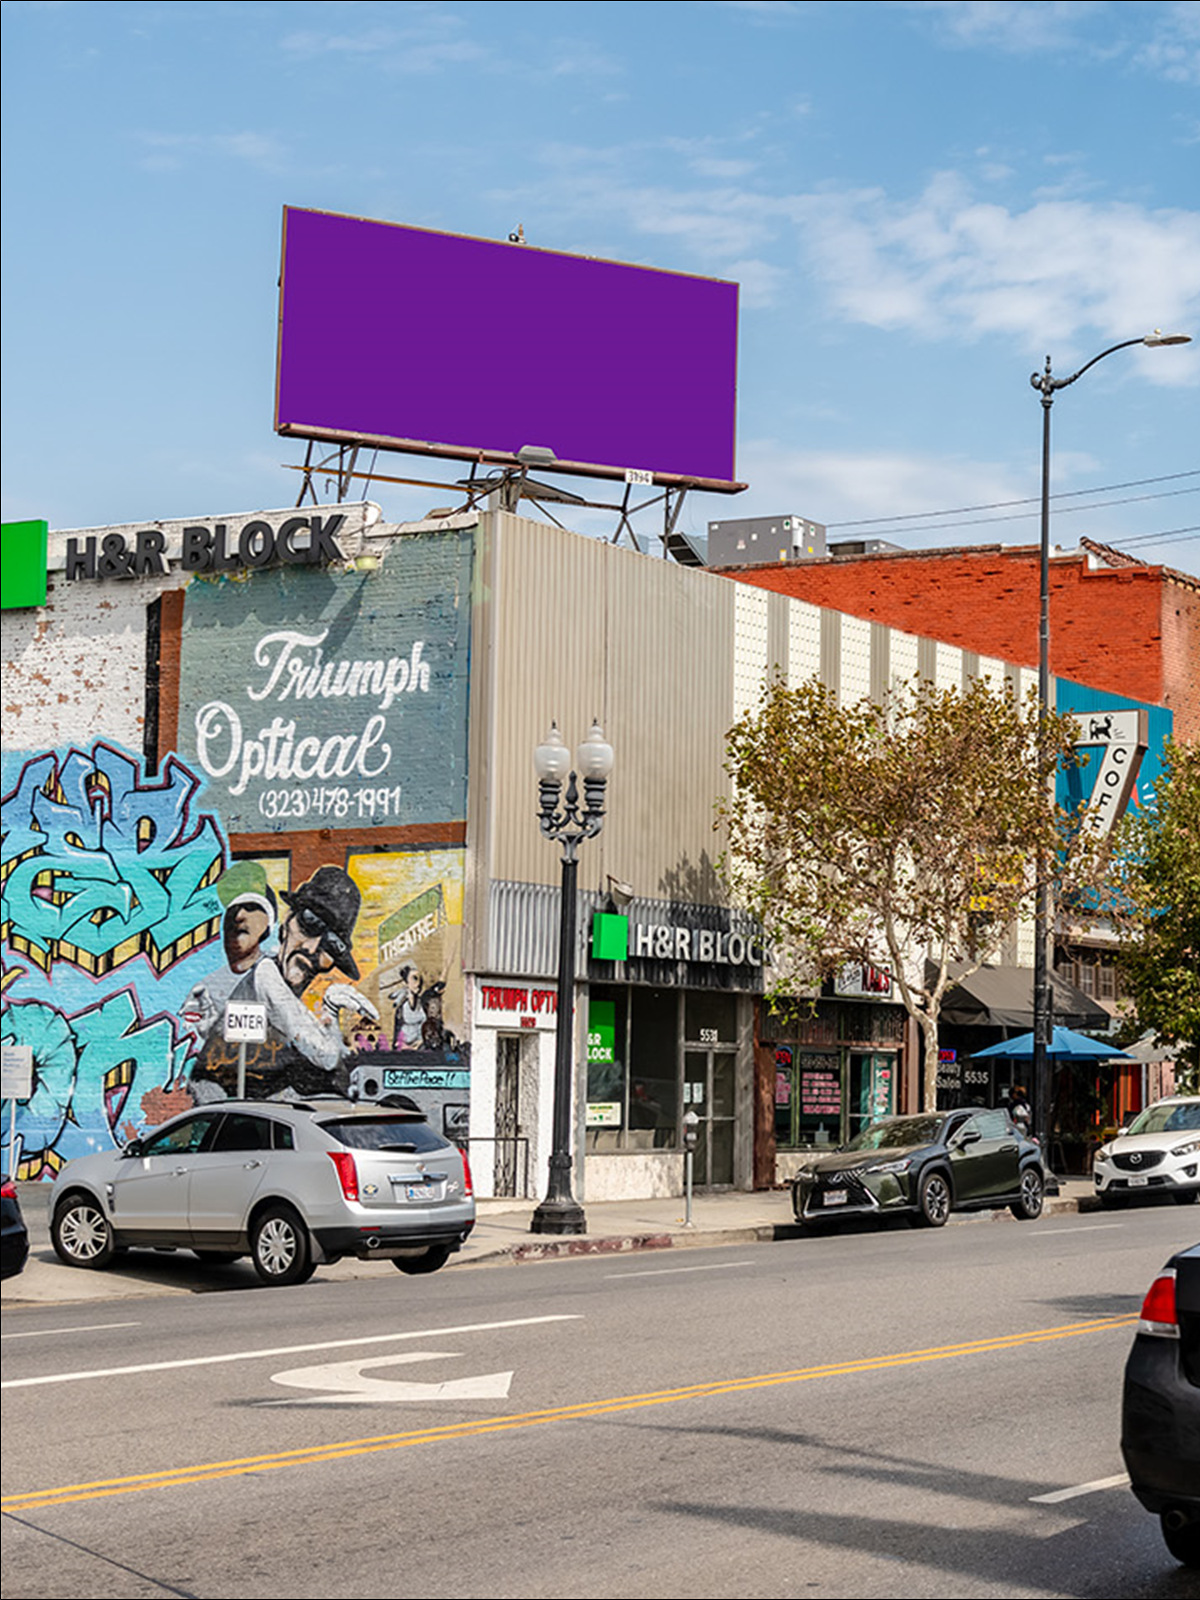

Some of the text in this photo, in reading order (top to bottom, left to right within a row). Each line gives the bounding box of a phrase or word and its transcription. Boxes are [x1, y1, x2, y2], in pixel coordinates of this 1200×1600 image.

[66, 514, 347, 581] H&R BLOCK
[247, 628, 431, 710] Triumph
[195, 701, 392, 796] Optical
[381, 912, 436, 961] THEATRE
[636, 923, 691, 961] H&R
[482, 985, 528, 1011] TRIUMPH
[228, 1014, 264, 1031] ENTER
[587, 1033, 601, 1046] &R
[587, 1047, 612, 1060] LOCK
[964, 1070, 989, 1084] 5535
